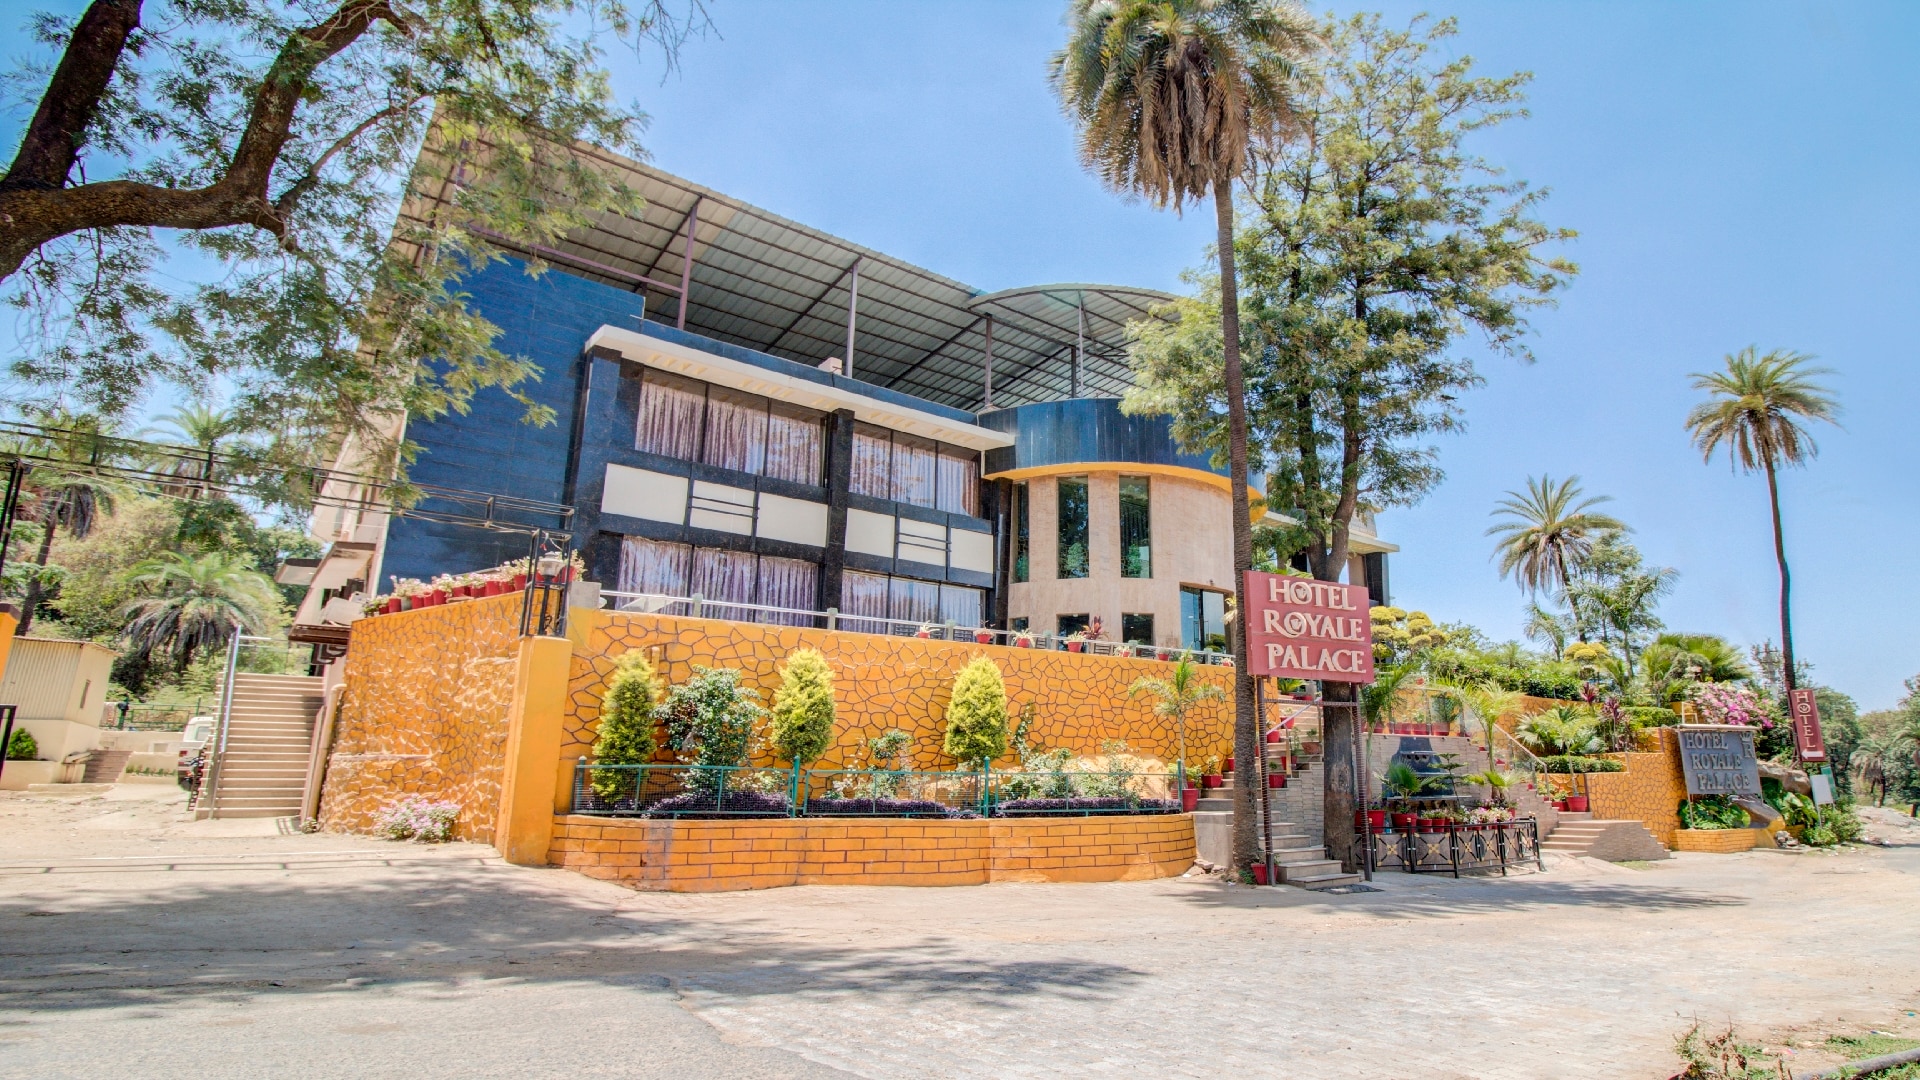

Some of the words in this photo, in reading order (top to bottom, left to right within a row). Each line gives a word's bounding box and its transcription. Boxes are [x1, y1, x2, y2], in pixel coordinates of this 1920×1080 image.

[1269, 577, 1357, 611] HOTEL
[1263, 609, 1365, 642] ROYALE
[1264, 643, 1367, 674] PALACE
[1794, 691, 1816, 748] HOTEL
[1684, 732, 1729, 750] HOTEL
[1691, 753, 1743, 770] ROYALE
[1697, 772, 1751, 790] PALACE
